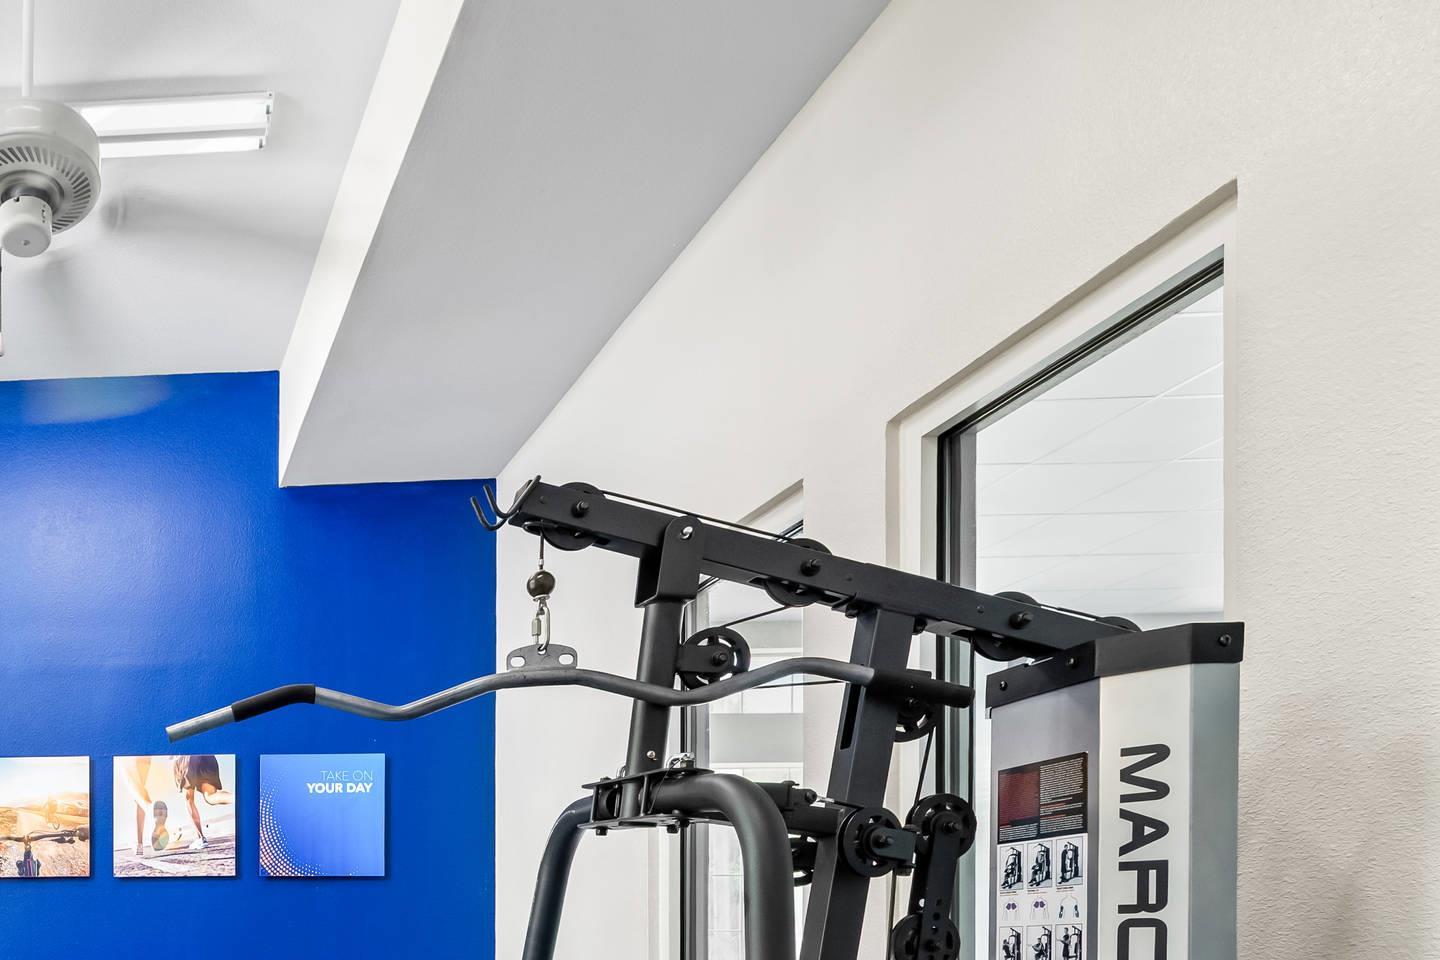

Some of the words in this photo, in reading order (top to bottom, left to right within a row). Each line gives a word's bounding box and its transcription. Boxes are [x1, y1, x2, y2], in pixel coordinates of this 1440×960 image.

[320, 770, 349, 781] TAKE
[352, 769, 373, 782] ON
[306, 782, 343, 794] YOUR
[346, 782, 373, 793] DAY
